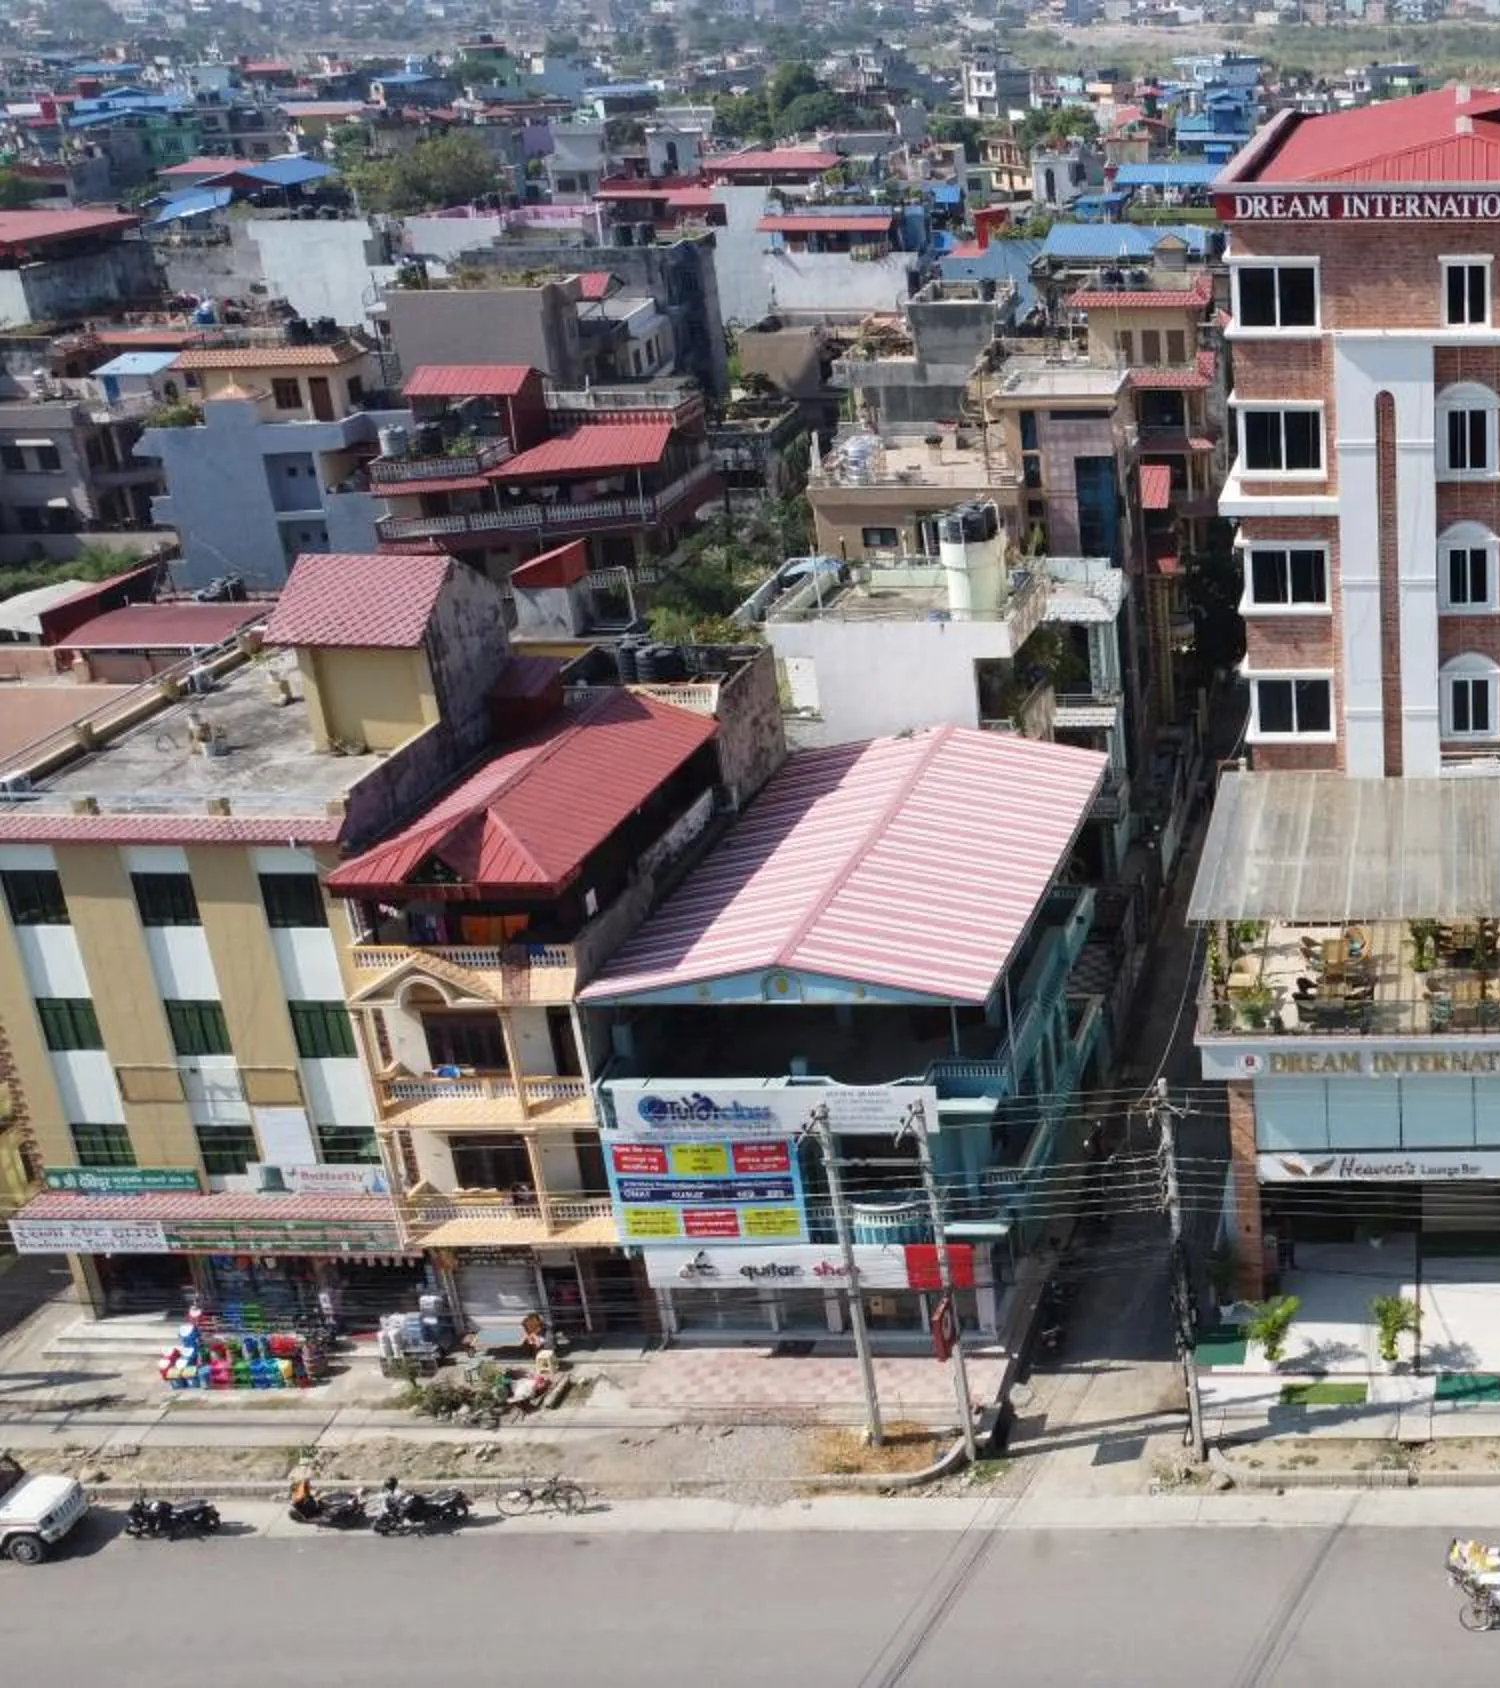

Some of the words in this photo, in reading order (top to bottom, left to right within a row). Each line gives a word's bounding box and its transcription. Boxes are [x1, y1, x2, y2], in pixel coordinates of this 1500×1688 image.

[1235, 194, 1330, 219] DREAM
[1269, 1051, 1361, 1074] DREAM
[1339, 1156, 1416, 1177] Heaven's
